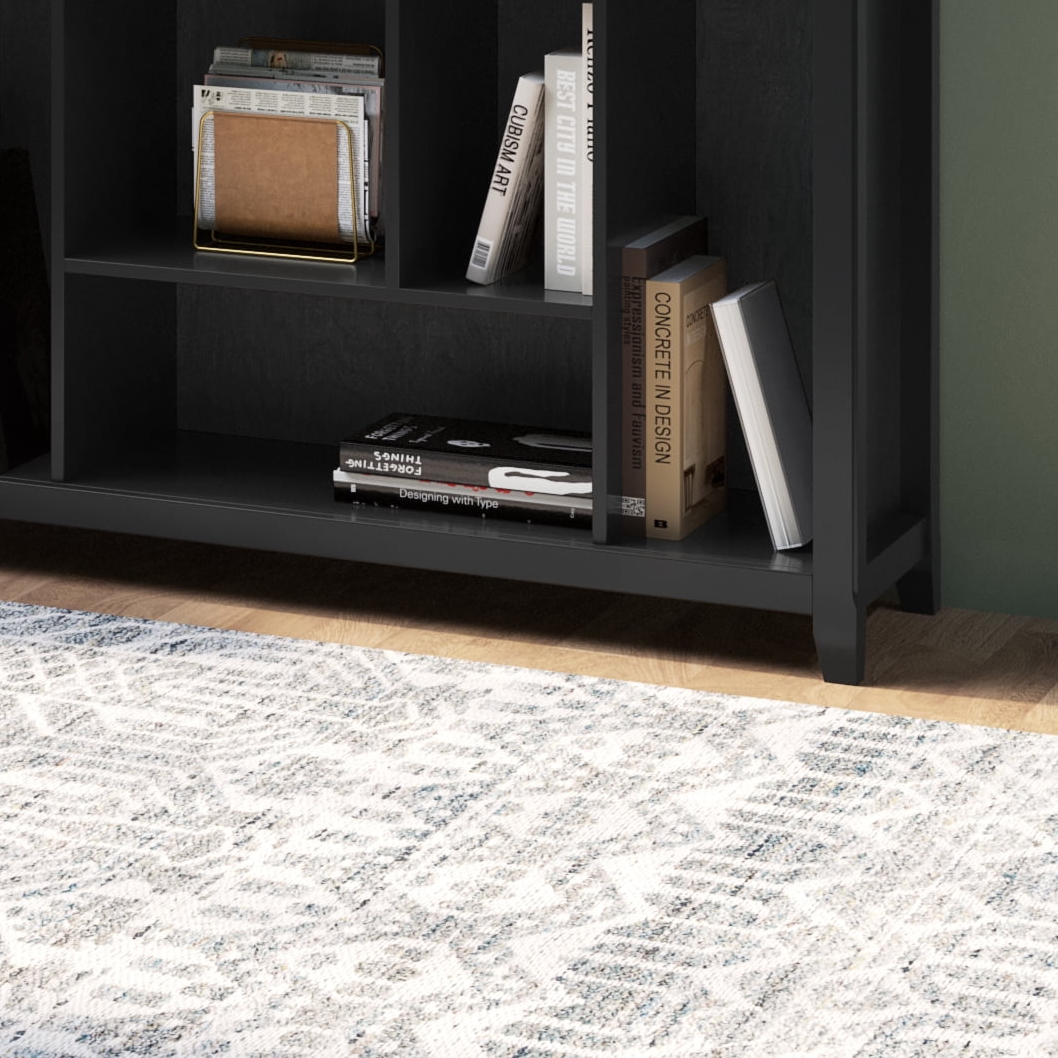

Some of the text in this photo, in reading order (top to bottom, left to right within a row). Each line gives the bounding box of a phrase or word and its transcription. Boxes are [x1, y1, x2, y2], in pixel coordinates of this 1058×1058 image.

[556, 69, 576, 112] BEST
[492, 104, 528, 196] CUBISM ART
[556, 114, 576, 153] CITY
[556, 182, 576, 214] THE
[556, 217, 576, 276] WORLD
[621, 276, 631, 345] painting styles
[631, 276, 646, 469] Expressionism and Fauvism
[654, 292, 672, 465] CONCRETE IN DESIGN
[345, 458, 422, 476] FORGETTING
[373, 451, 422, 465] THINGS
[399, 487, 499, 509] Designing with Type
